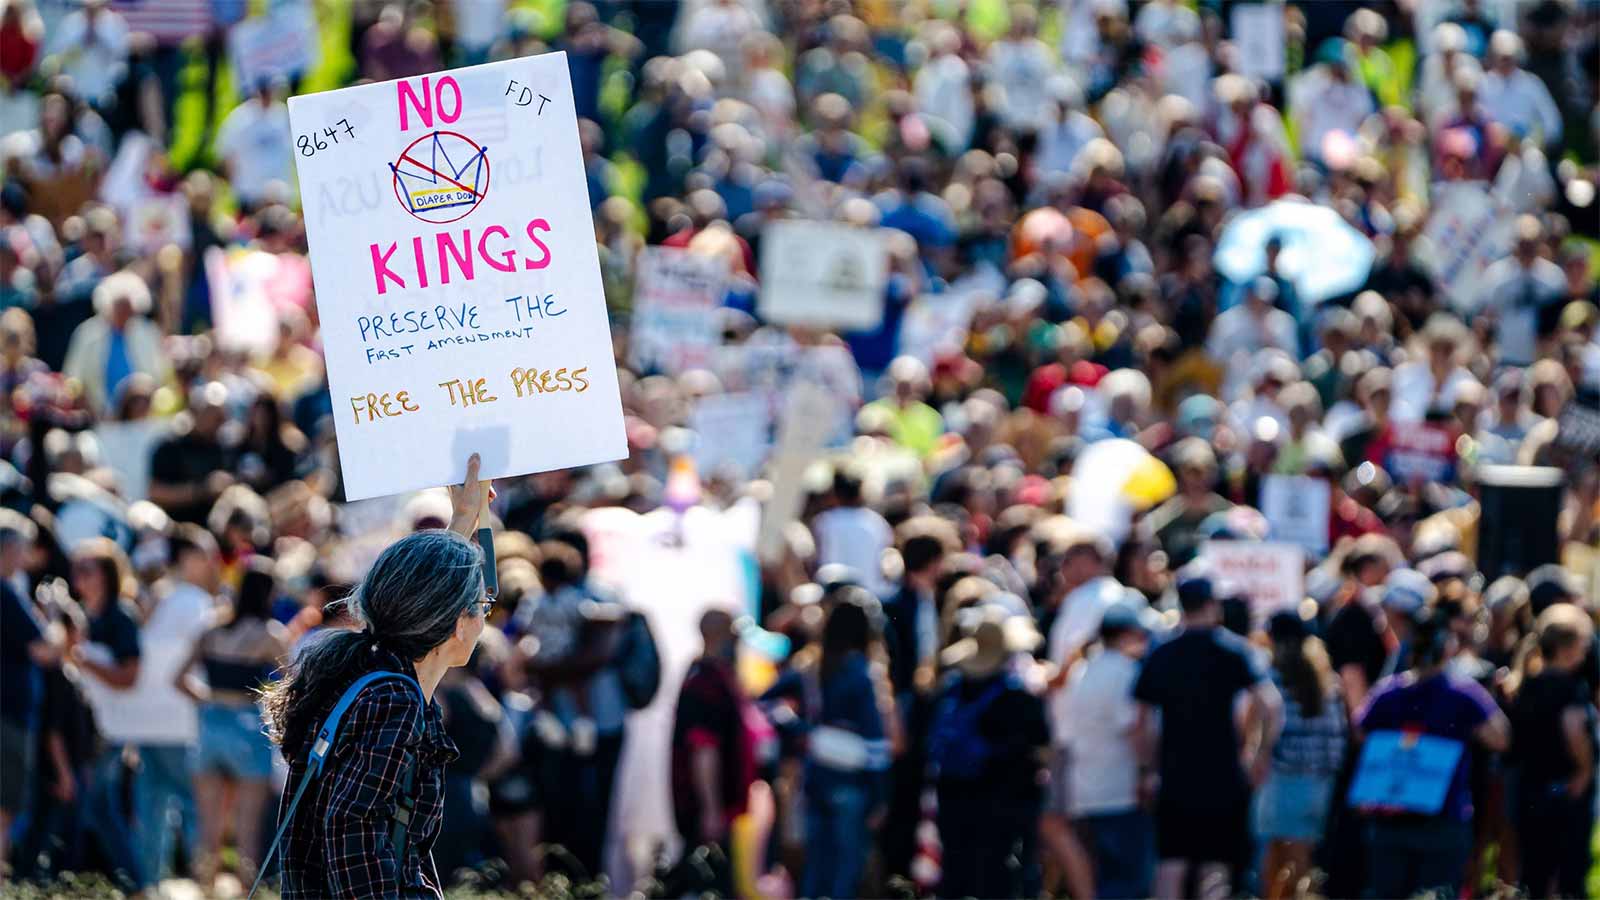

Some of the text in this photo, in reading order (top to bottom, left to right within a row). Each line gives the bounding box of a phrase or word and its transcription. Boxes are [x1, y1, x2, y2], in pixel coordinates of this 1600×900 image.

[397, 75, 462, 132] NO
[504, 79, 552, 116] FDT
[296, 118, 355, 158] 8647
[370, 218, 552, 295] KINGS
[357, 294, 568, 343] PRESERVE THE
[365, 327, 534, 365] FIRST AMENDMENT
[350, 367, 589, 425] FREE THE PRESS
